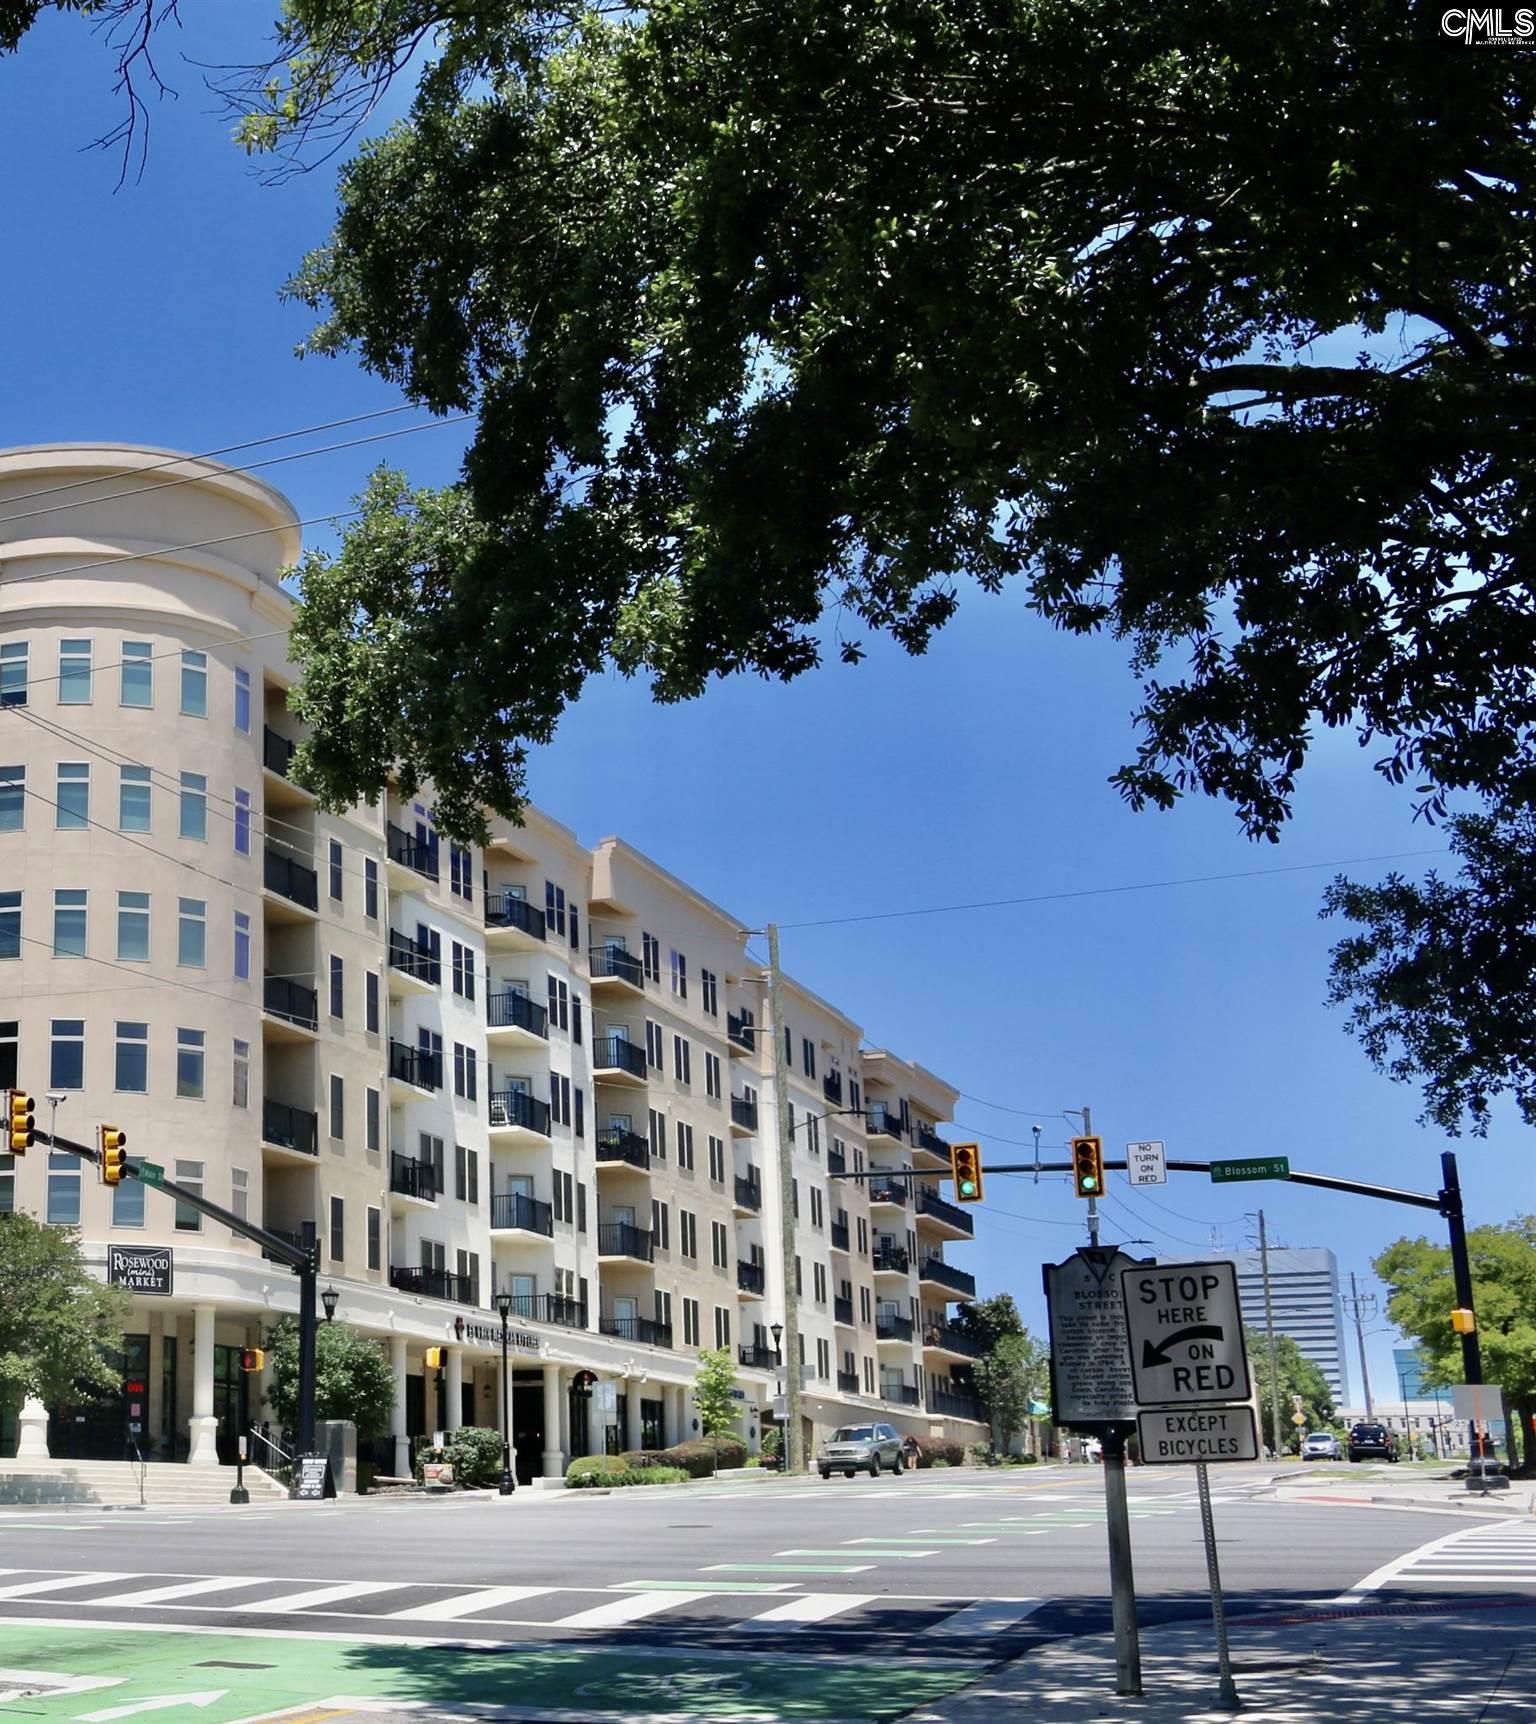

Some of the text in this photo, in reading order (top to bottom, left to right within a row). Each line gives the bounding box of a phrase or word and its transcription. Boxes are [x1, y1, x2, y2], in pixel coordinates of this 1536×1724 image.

[1138, 1143, 1152, 1152] NO
[1134, 1153, 1159, 1163] TURN
[1140, 1164, 1154, 1173] ON
[1224, 1163, 1285, 1177] Blossom St
[1138, 1174, 1158, 1183] RED
[118, 1275, 164, 1288] MARKET
[1074, 1289, 1122, 1300] BLOSSO
[1138, 1275, 1220, 1304] STOP
[1079, 1300, 1123, 1310] STREET
[1158, 1306, 1208, 1324] HERE
[1187, 1344, 1215, 1361] ON
[1173, 1364, 1235, 1392] RED
[1166, 1415, 1228, 1433] EXCEPT
[1159, 1437, 1239, 1457] BICYCLES
